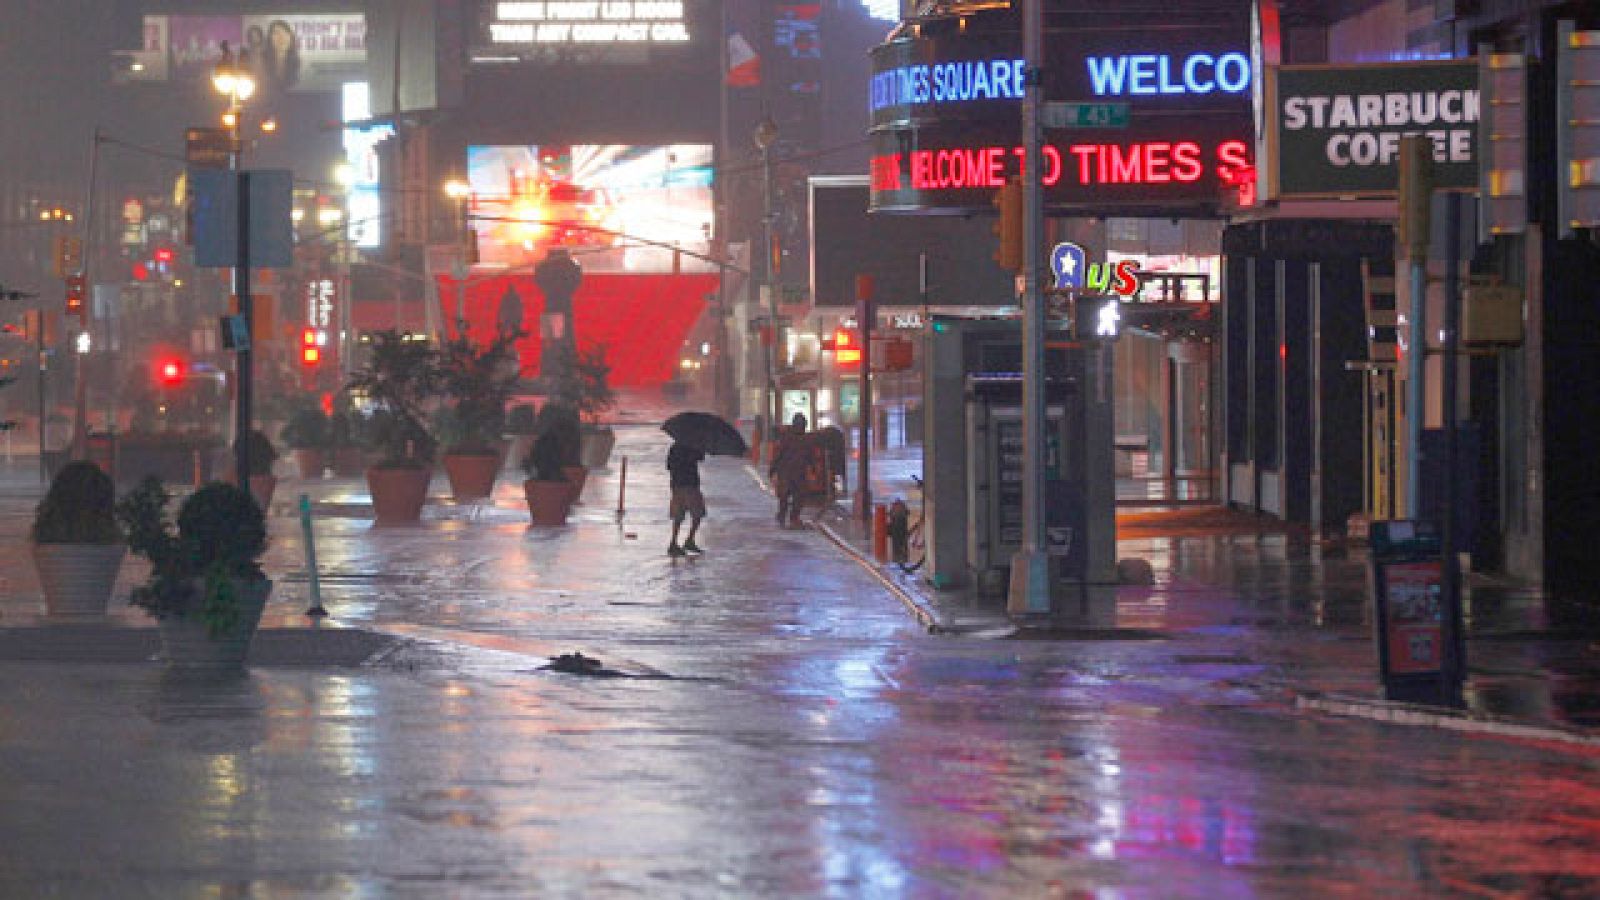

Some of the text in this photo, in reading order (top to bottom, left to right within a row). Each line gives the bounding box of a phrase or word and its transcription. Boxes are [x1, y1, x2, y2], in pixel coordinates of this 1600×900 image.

[933, 59, 1026, 101] SQUARE
[1086, 53, 1250, 96] WELCO
[1070, 141, 1201, 185] TIMES
[1325, 130, 1471, 167] COFEE
